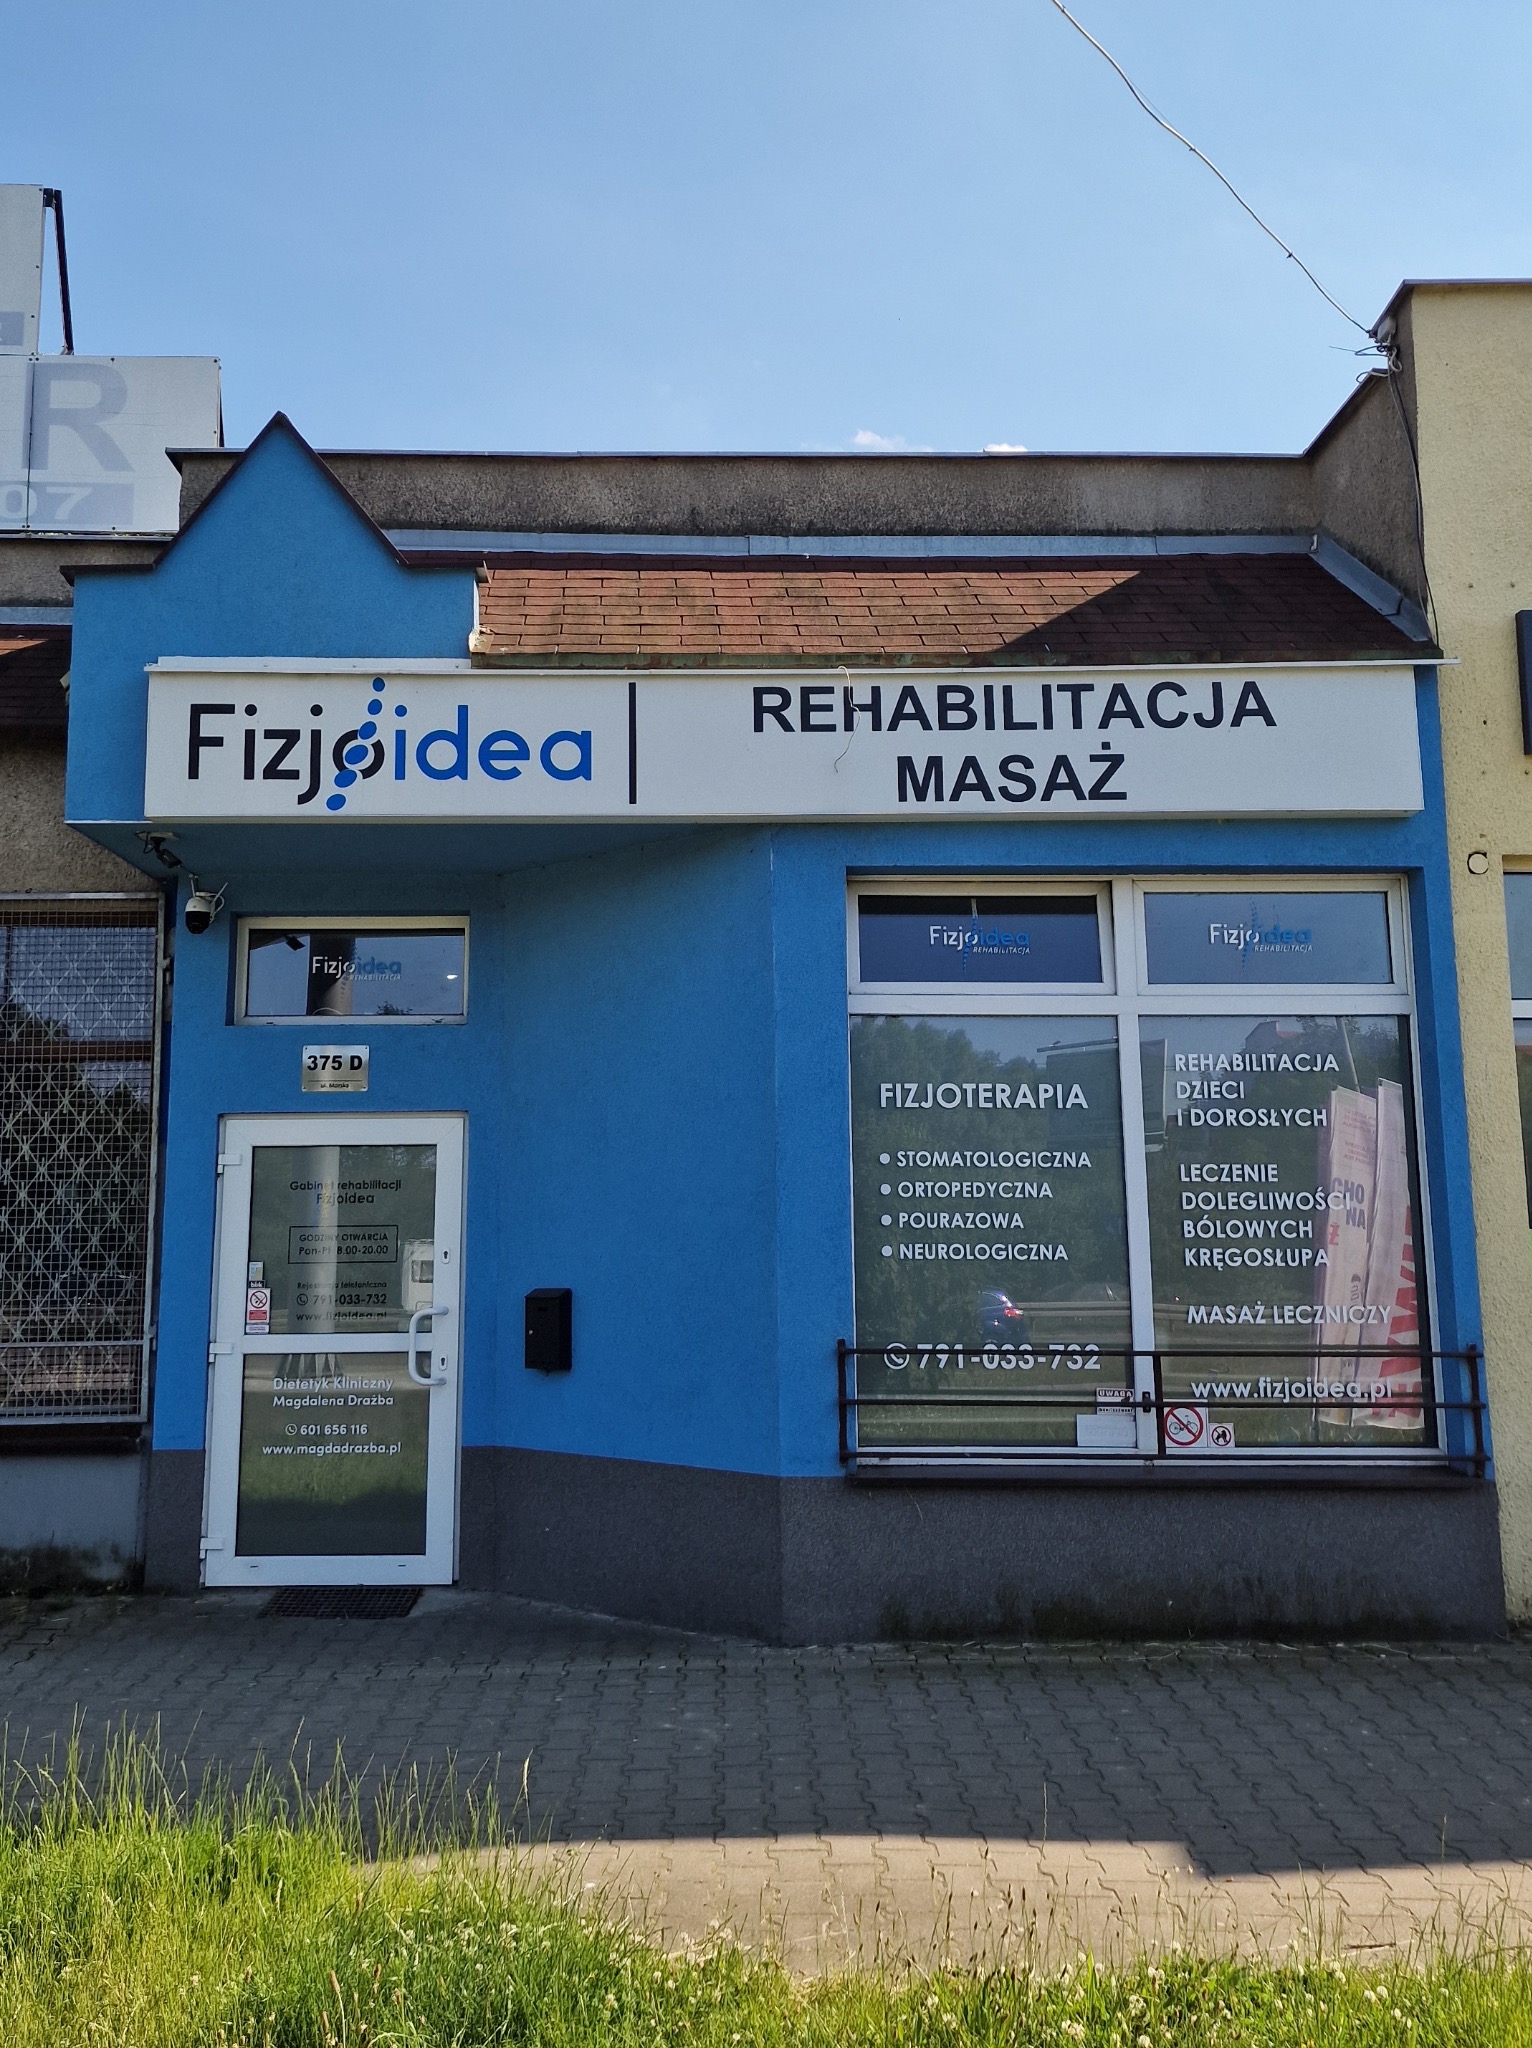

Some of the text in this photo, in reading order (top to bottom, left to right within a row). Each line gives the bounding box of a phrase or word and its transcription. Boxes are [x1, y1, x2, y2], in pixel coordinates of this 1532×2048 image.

[753, 681, 1277, 733] REHABILITACJA
[188, 700, 592, 806] Fizjoidea
[897, 741, 1127, 802] MASAŻ
[929, 926, 1030, 950] Fizjoidea
[1209, 923, 1312, 950] Fizjoidea
[973, 946, 1031, 955] REHABILITACJA
[1255, 945, 1313, 954] REHABILITACJA
[312, 956, 402, 978] Fizjoidea
[307, 1055, 363, 1070] 375 D
[1174, 1053, 1340, 1072] REHABILITACJA
[880, 1083, 1089, 1109] FIZJOTERAPIA
[1176, 1081, 1245, 1099] DZIECI
[1177, 1109, 1183, 1126] I
[1191, 1108, 1327, 1126] DOROSŁYCH
[896, 1151, 1092, 1168] STOMATOLOGICZNA
[1180, 1164, 1278, 1182] LECZENIE
[290, 1180, 401, 1191] Gabinet rehabilitacji
[898, 1182, 1053, 1198] ORTOPEDYCZNA
[1182, 1187, 1351, 1210] DOLEGLIWOŚCI
[899, 1213, 1024, 1229] POURAZOWA
[1183, 1215, 1312, 1238] BÓLOWYCH
[299, 1233, 388, 1242] GODZINY OTWARCIA
[337, 1245, 389, 1255] 8.00-20.00
[899, 1244, 1068, 1260] NEUROLOGICZNA
[1184, 1248, 1329, 1270] KRĘGOSŁUPA
[313, 1294, 387, 1305] 791-033-732
[296, 1311, 387, 1322] www.fizjoidea.pl
[1188, 1301, 1391, 1324] MASAŻ LECZNICZY
[917, 1343, 1100, 1370] 791-033-732
[273, 1377, 393, 1392] Dietetyk Kliniczny
[1191, 1377, 1392, 1403] www.fizjoidea.pl
[273, 1395, 394, 1409] Magdalena Drażba
[300, 1425, 368, 1435] 601 656 116
[262, 1443, 402, 1456] www.magdadrazba.pl
